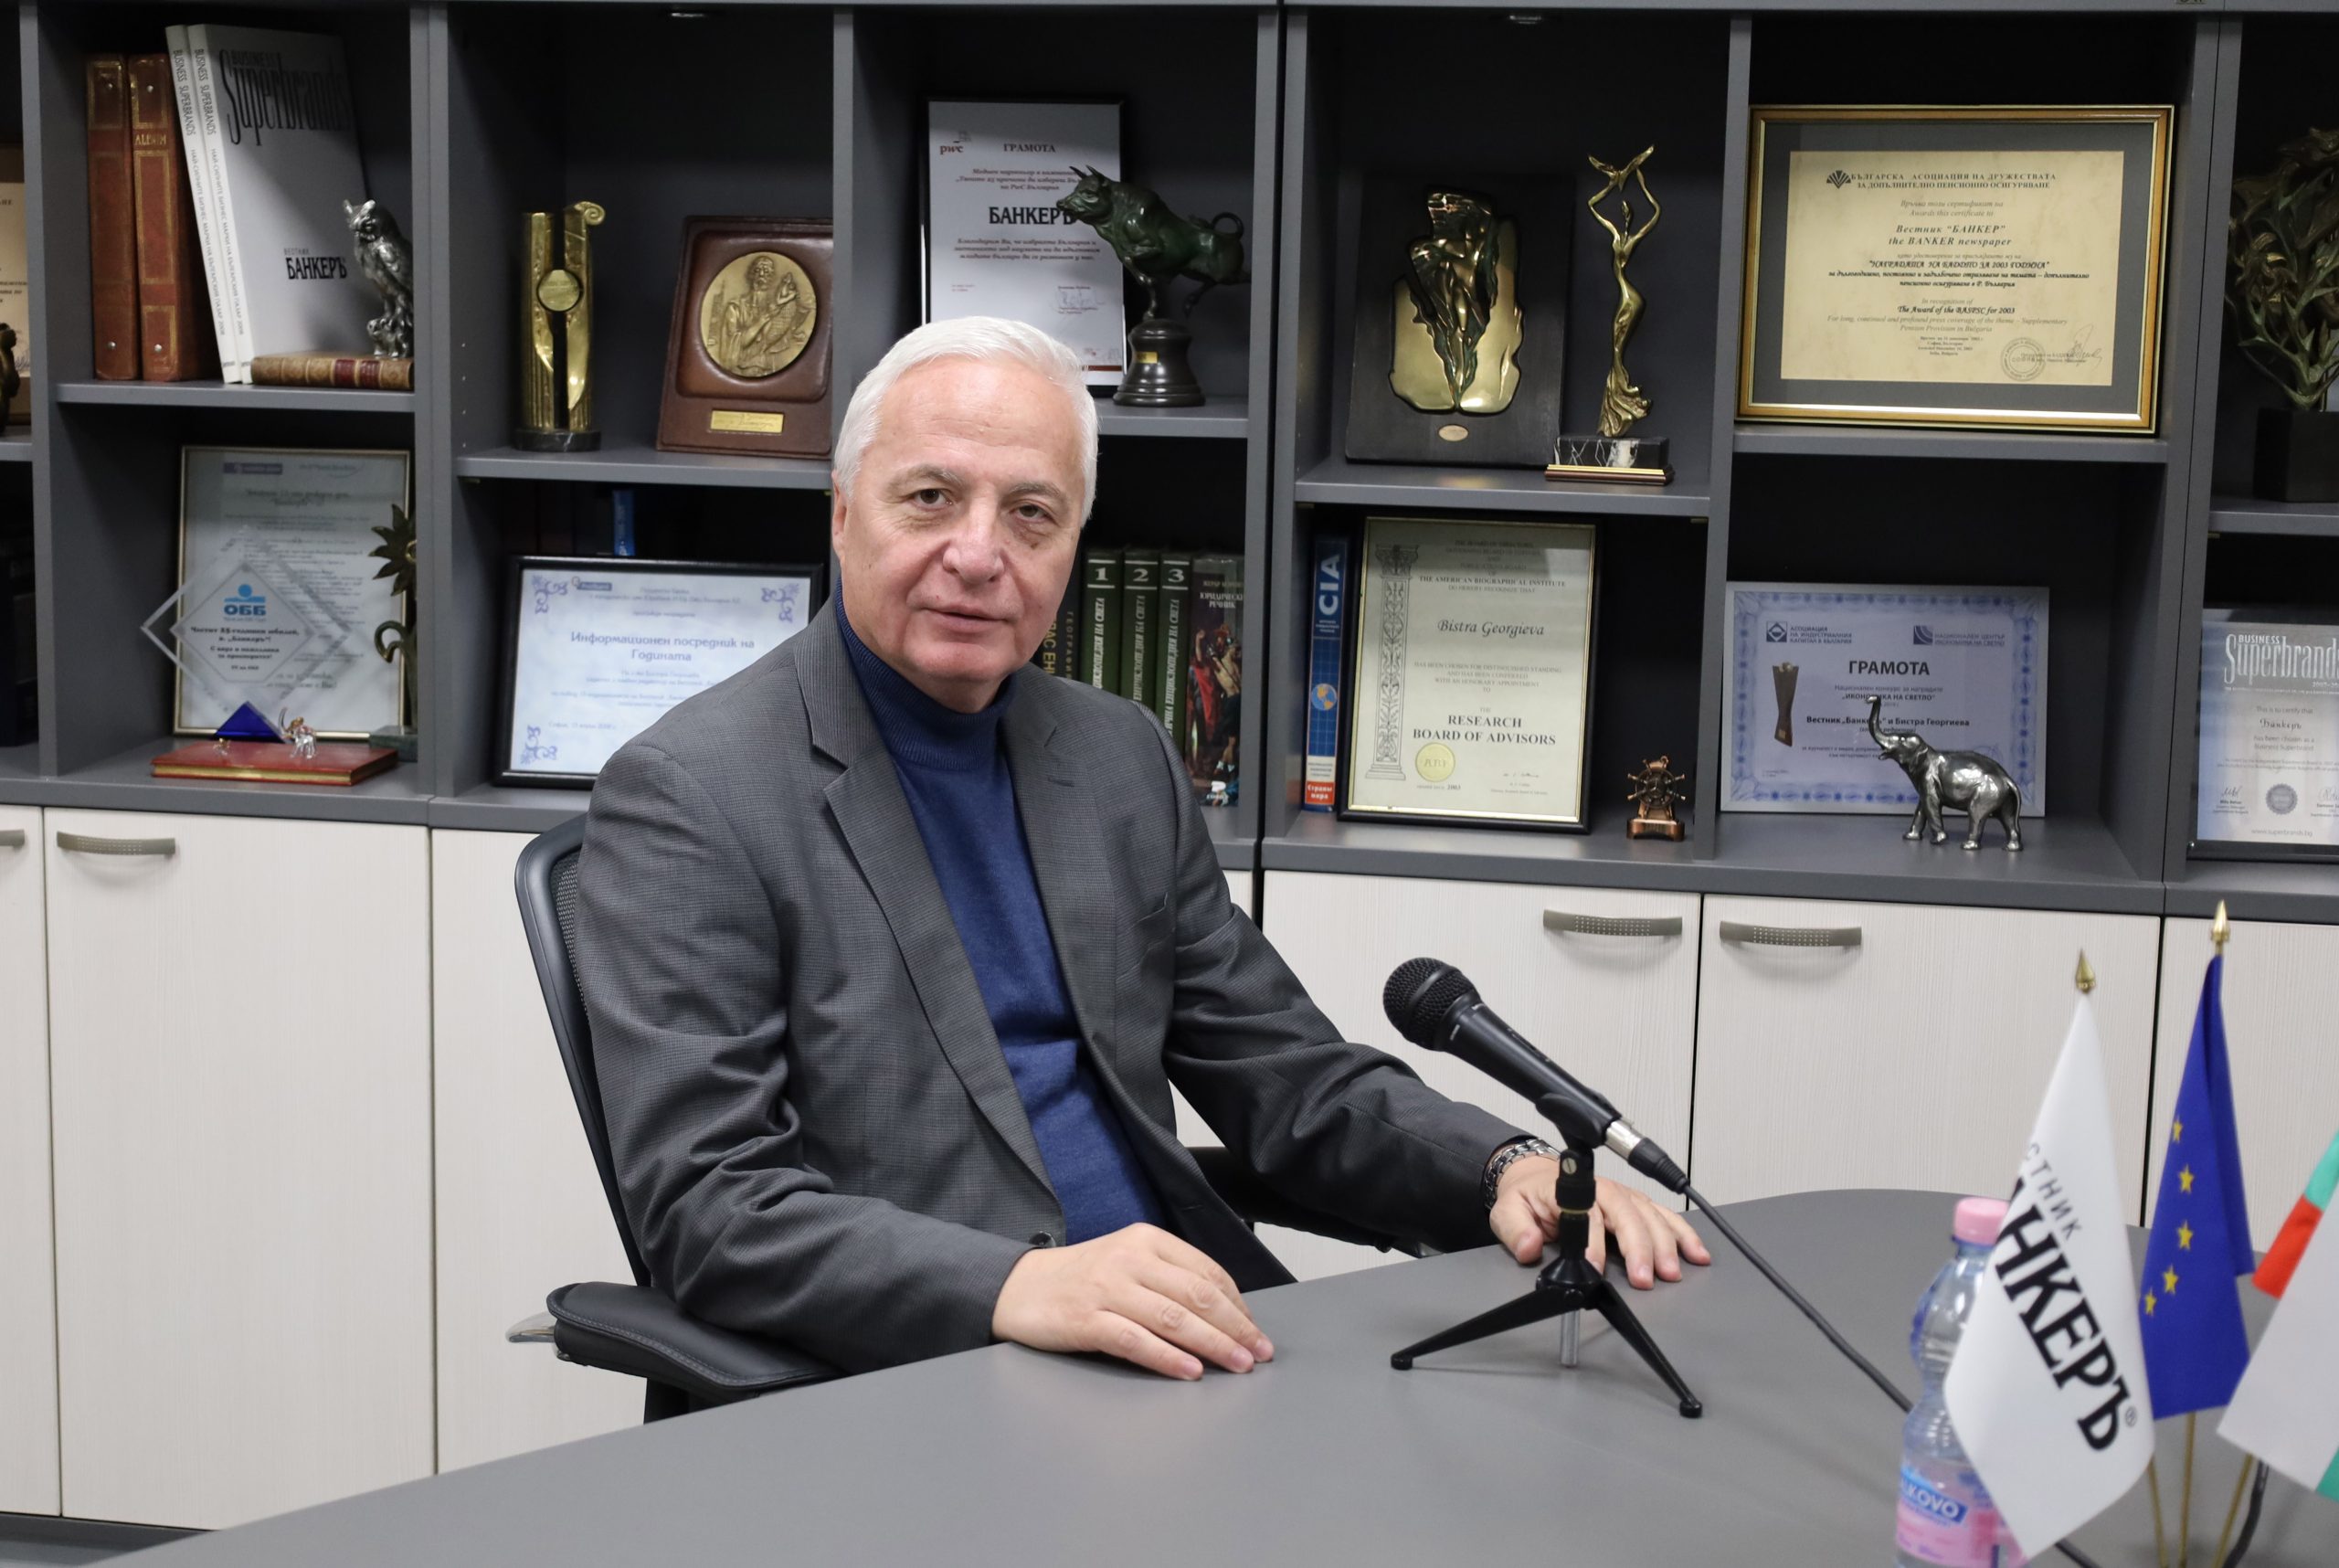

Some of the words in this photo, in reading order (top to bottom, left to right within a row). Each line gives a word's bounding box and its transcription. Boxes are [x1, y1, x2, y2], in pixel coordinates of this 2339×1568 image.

[195, 48, 208, 81] BUSINESS
[200, 85, 217, 136] SUPERBRANDS
[939, 144, 964, 155] pwc
[1003, 143, 1056, 154] ГРАМОТА
[1850, 173, 1904, 181] БЪЛГАРСКА
[1912, 173, 1969, 181] АСОЦИАЦИЯ
[1973, 173, 1984, 181] НА
[1987, 173, 2056, 181] ДРУЖЕСТВАТА
[1950, 209, 1985, 218] certificate
[1896, 225, 1943, 234] Вестник
[1889, 237, 1904, 246] the
[1908, 237, 1955, 246] BANKER
[1958, 238, 2013, 248] newspaper
[285, 256, 348, 280] БАНКЕРЪ
[1898, 305, 1910, 313] The
[1910, 305, 1934, 314] Award
[1935, 305, 1943, 315] of
[1944, 306, 1954, 314] the
[1986, 307, 1997, 316] for
[1095, 567, 1108, 581] 1
[1133, 568, 1149, 582] 2
[1168, 568, 1185, 582] 3
[1318, 554, 1340, 616] CIA
[1435, 576, 1473, 584] AMERICAN
[1474, 577, 1527, 586] BIOGRAPHICAL
[1529, 578, 1566, 588] INSTITUTE
[224, 604, 266, 616] ОББ
[1169, 625, 1179, 638] НА
[1437, 619, 1478, 633] Bistra
[1481, 620, 1545, 639] Georgieva
[570, 630, 671, 647] Информационен
[673, 635, 737, 649] посредник
[741, 640, 755, 649] на
[2238, 634, 2280, 644] BUSINESS
[631, 649, 692, 662] Годината
[1165, 638, 1179, 705] ЕНЦИКЛОПЕДИЯ
[1848, 660, 1931, 676] ГРАМОТА
[1448, 715, 1522, 728] RESEARCH
[1806, 715, 1841, 724] Вестник
[1895, 717, 1925, 726] Бистра
[1926, 718, 1970, 727] Георгиева
[1413, 728, 1461, 741] BOARD
[1464, 730, 1484, 742] OF
[1486, 732, 1556, 746] ADVISORS
